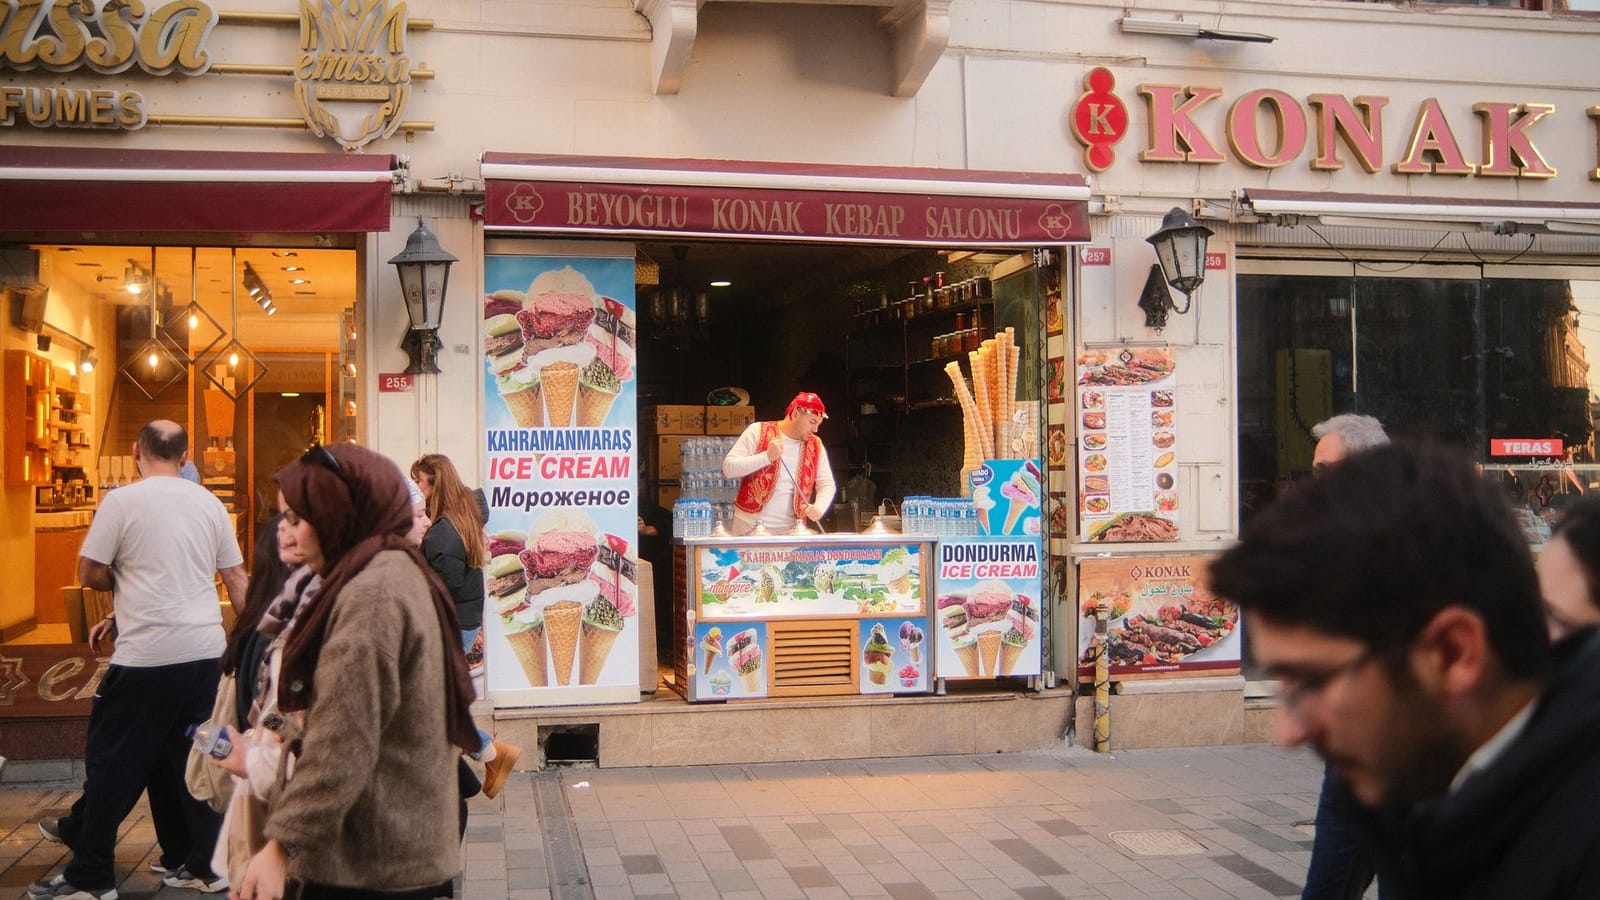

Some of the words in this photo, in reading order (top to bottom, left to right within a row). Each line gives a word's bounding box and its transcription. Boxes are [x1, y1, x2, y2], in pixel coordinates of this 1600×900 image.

[297, 54, 409, 83] emissa
[1087, 103, 1116, 135] K
[1137, 83, 1557, 179] KONAK
[567, 187, 688, 229] BEYOĞLU
[711, 198, 804, 233] KONAK
[824, 203, 904, 237] KEBAP
[926, 206, 1022, 239] SALONU
[1088, 251, 1104, 262] 257
[386, 377, 407, 388] 255
[488, 429, 632, 453] KAHRAMANMARAŞ
[1503, 441, 1552, 454] TERAS
[490, 457, 533, 480] ICE
[541, 456, 631, 479] CREAM
[491, 486, 631, 512] Мороженое
[942, 544, 1037, 563] DONDURMA
[941, 565, 972, 578] ICE
[976, 564, 1037, 578] CREAM
[1145, 565, 1191, 578] KONAK
